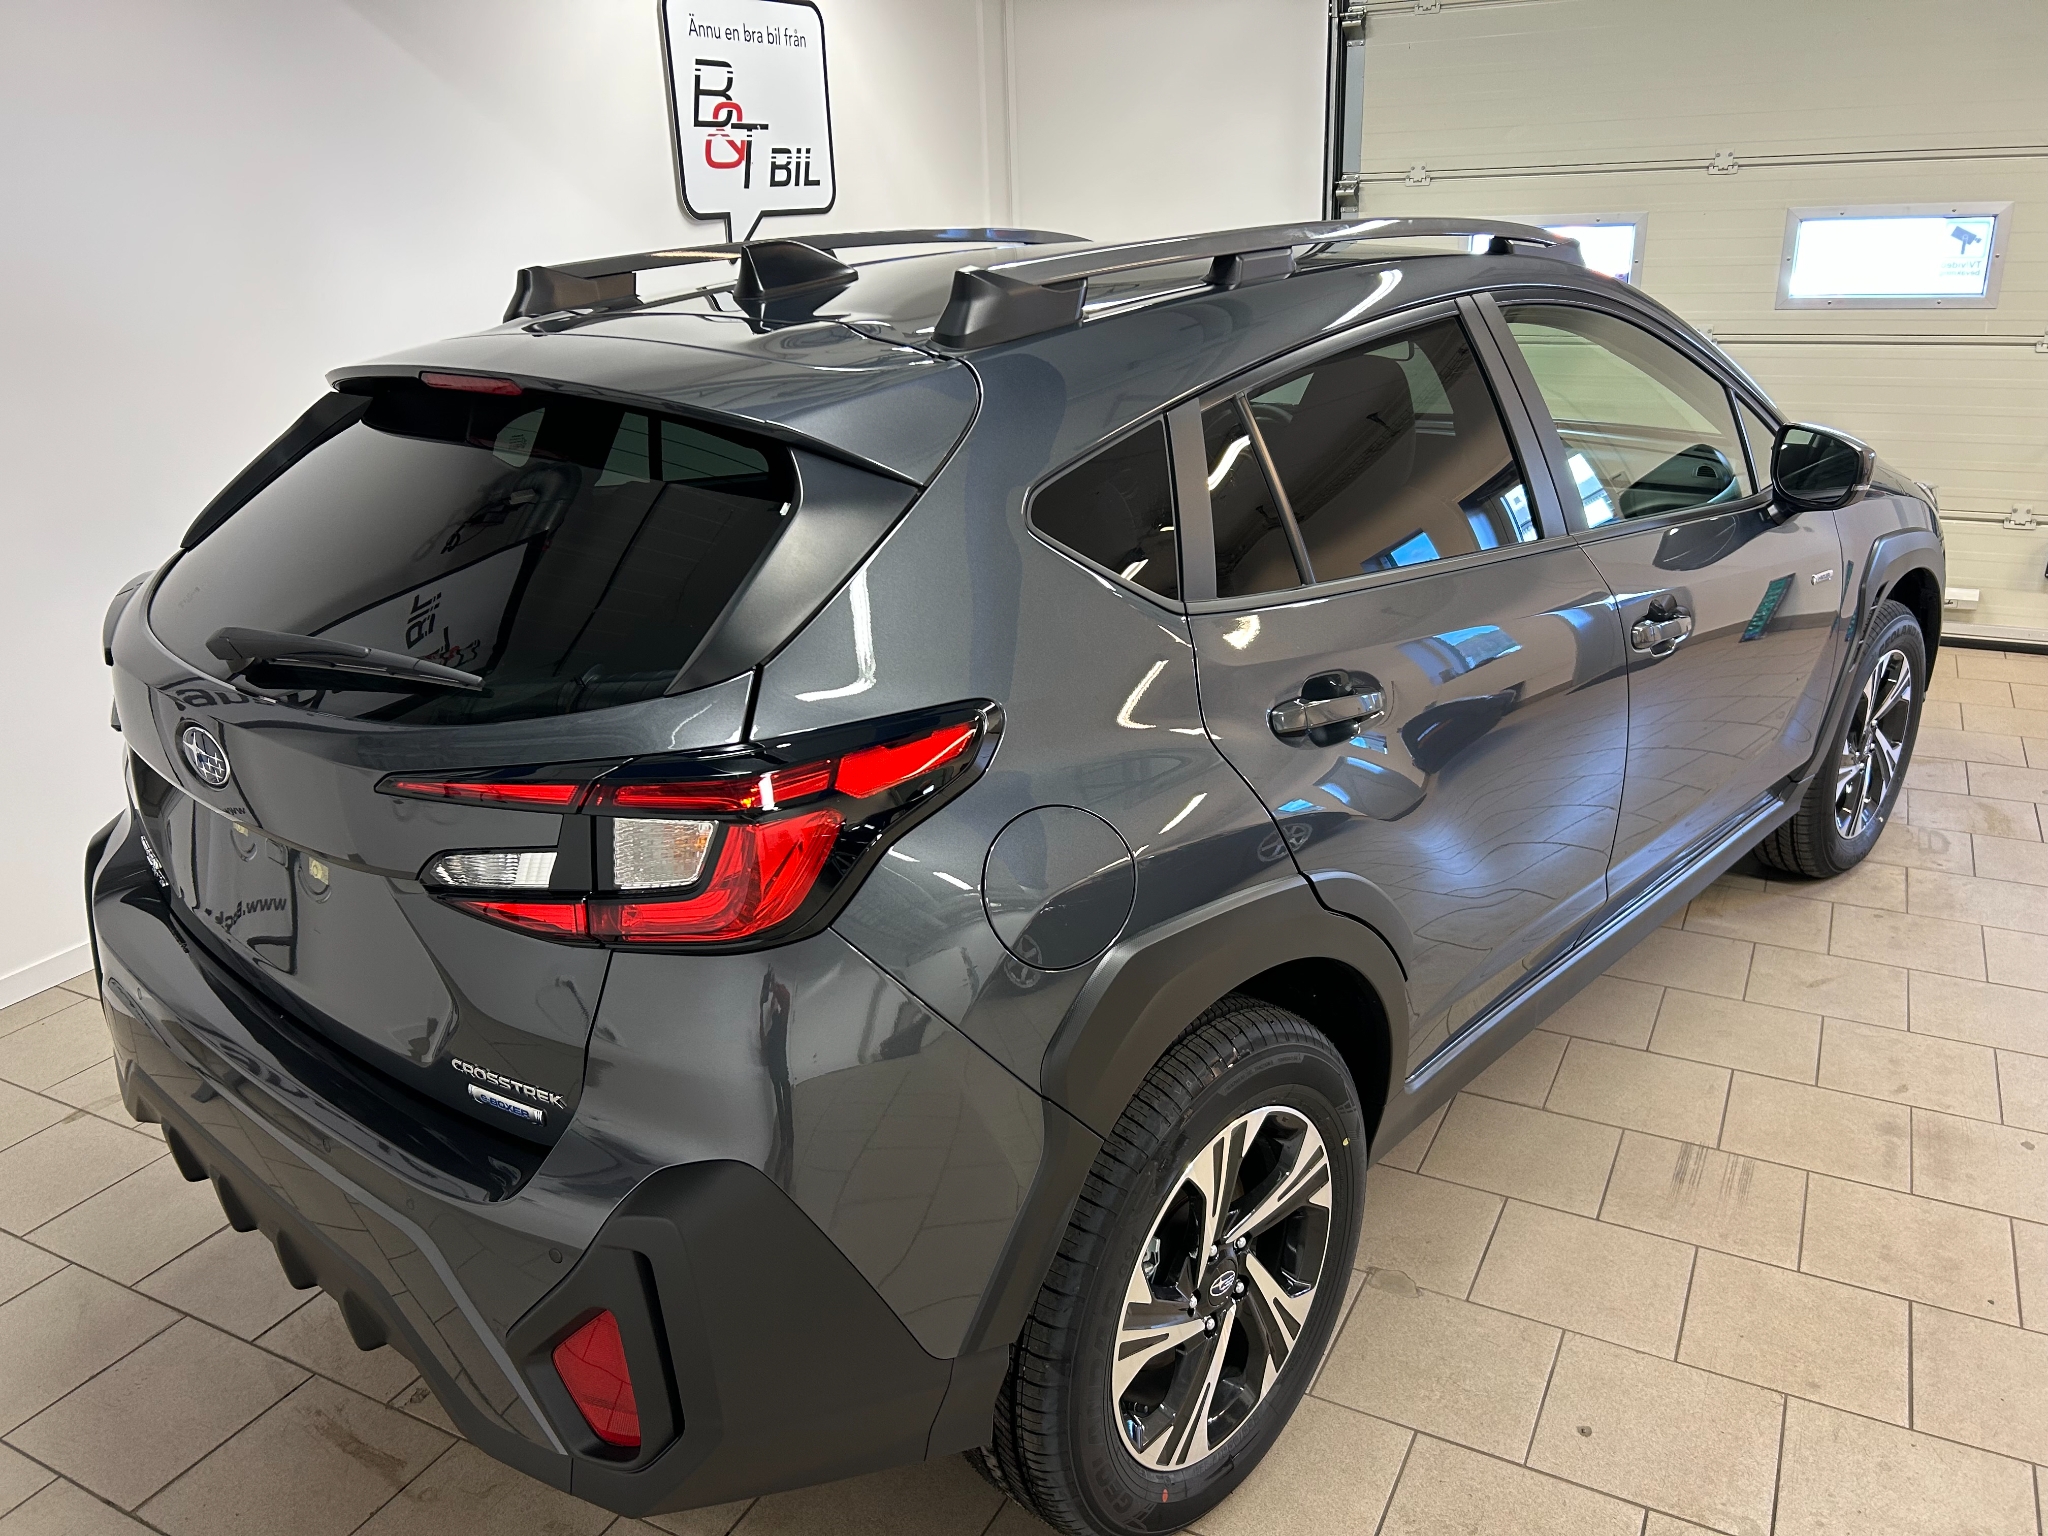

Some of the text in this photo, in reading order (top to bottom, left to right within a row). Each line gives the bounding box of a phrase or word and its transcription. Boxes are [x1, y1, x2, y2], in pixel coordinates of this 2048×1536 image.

[688, 13, 807, 48] Ännu en bra bil från
[769, 147, 820, 188] BIL
[451, 1058, 568, 1110] CROSSTREK
